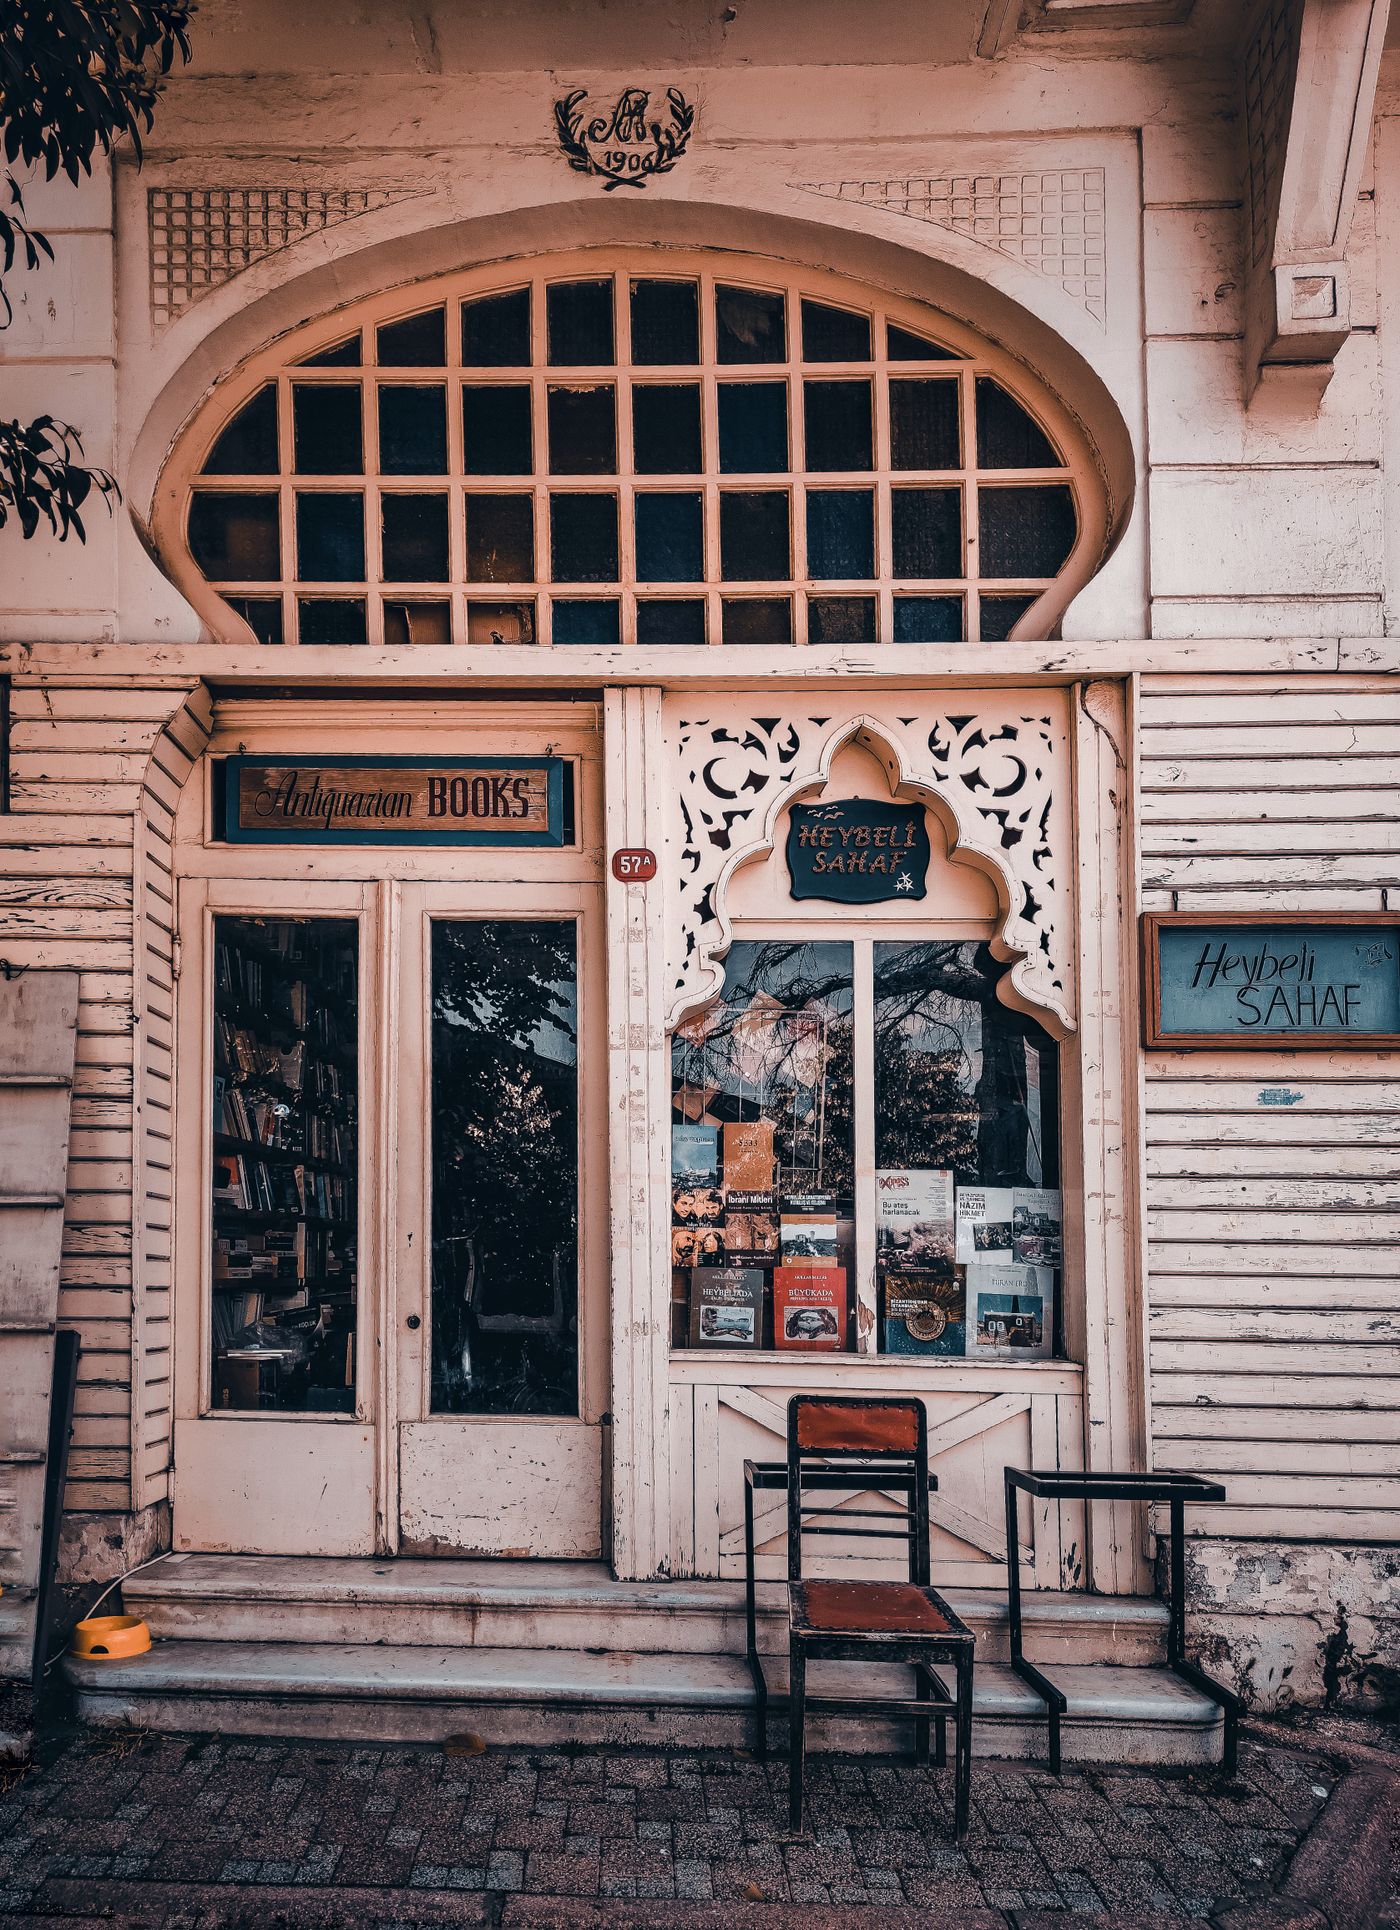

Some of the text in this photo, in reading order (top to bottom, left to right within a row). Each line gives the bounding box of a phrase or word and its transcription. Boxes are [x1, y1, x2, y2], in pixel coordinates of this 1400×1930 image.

[604, 151, 656, 173] 1906
[254, 770, 530, 829] Antiquarian BOOKS
[812, 850, 908, 874] SAHAF
[1191, 941, 1316, 998] Heybeli
[1236, 985, 1361, 1026] SAHAF
[882, 1201, 892, 1209] Bu
[788, 1288, 834, 1297] BÜYÜKADA
